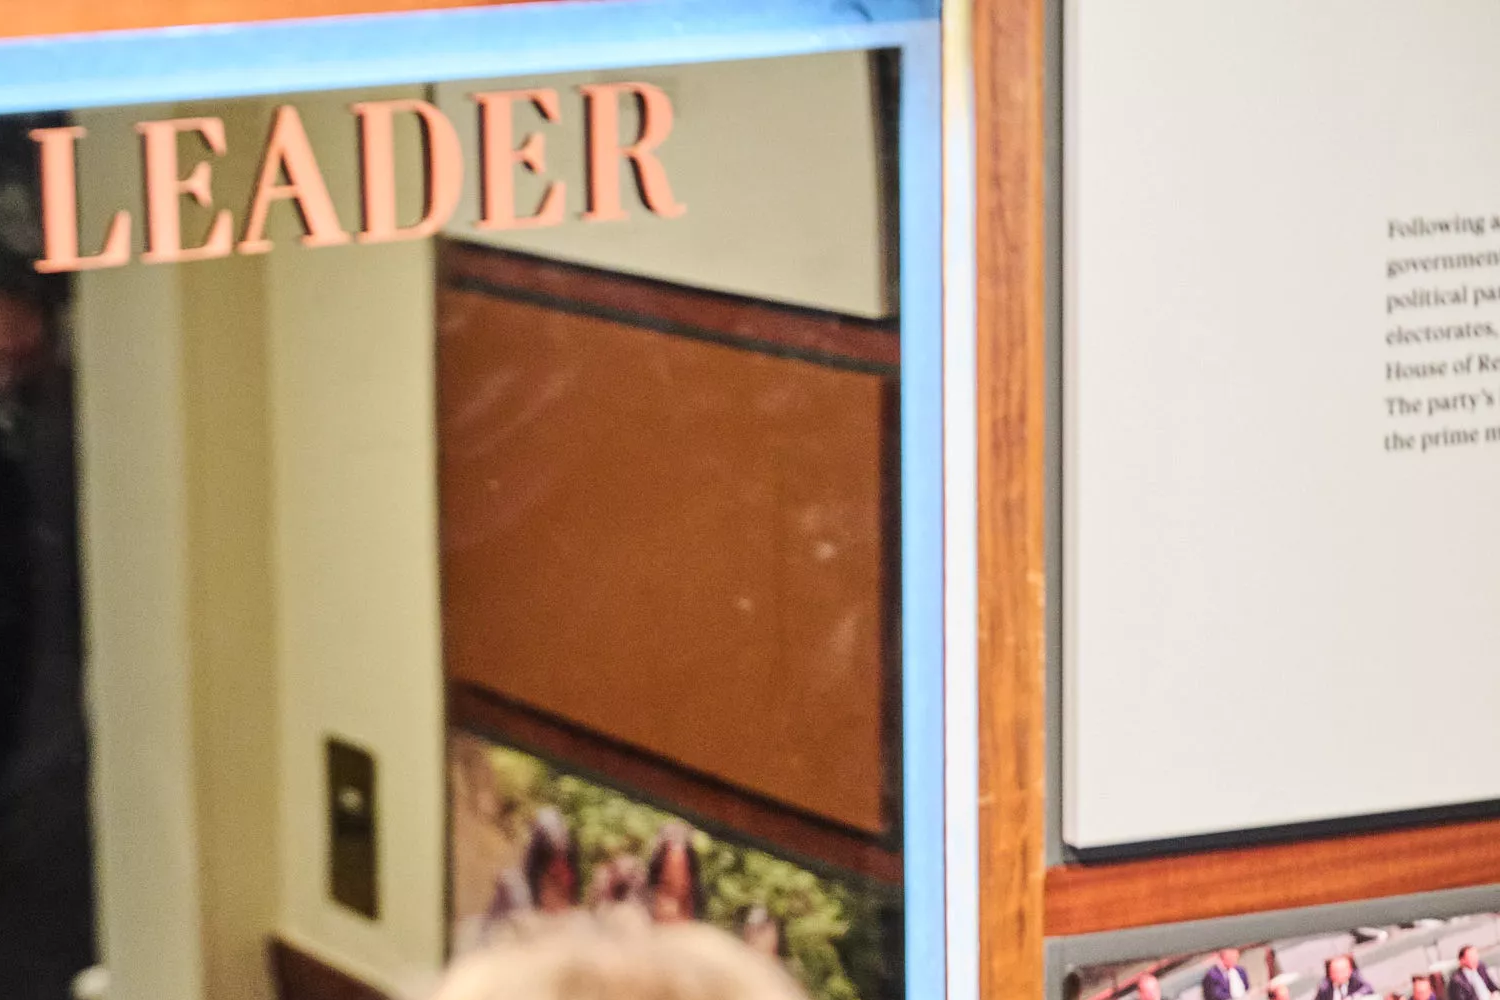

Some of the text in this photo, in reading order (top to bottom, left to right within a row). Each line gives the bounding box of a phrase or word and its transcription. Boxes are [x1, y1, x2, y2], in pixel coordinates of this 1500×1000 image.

[31, 81, 686, 273] LEADER
[1387, 212, 1485, 238] Following
[1386, 251, 1500, 278] governmen
[1386, 284, 1468, 314] political
[1385, 324, 1498, 345] electorates,
[1386, 361, 1447, 379] House
[1452, 354, 1473, 374] of
[1384, 396, 1422, 416] The
[1384, 431, 1415, 451] the
[1420, 427, 1479, 453] prime
